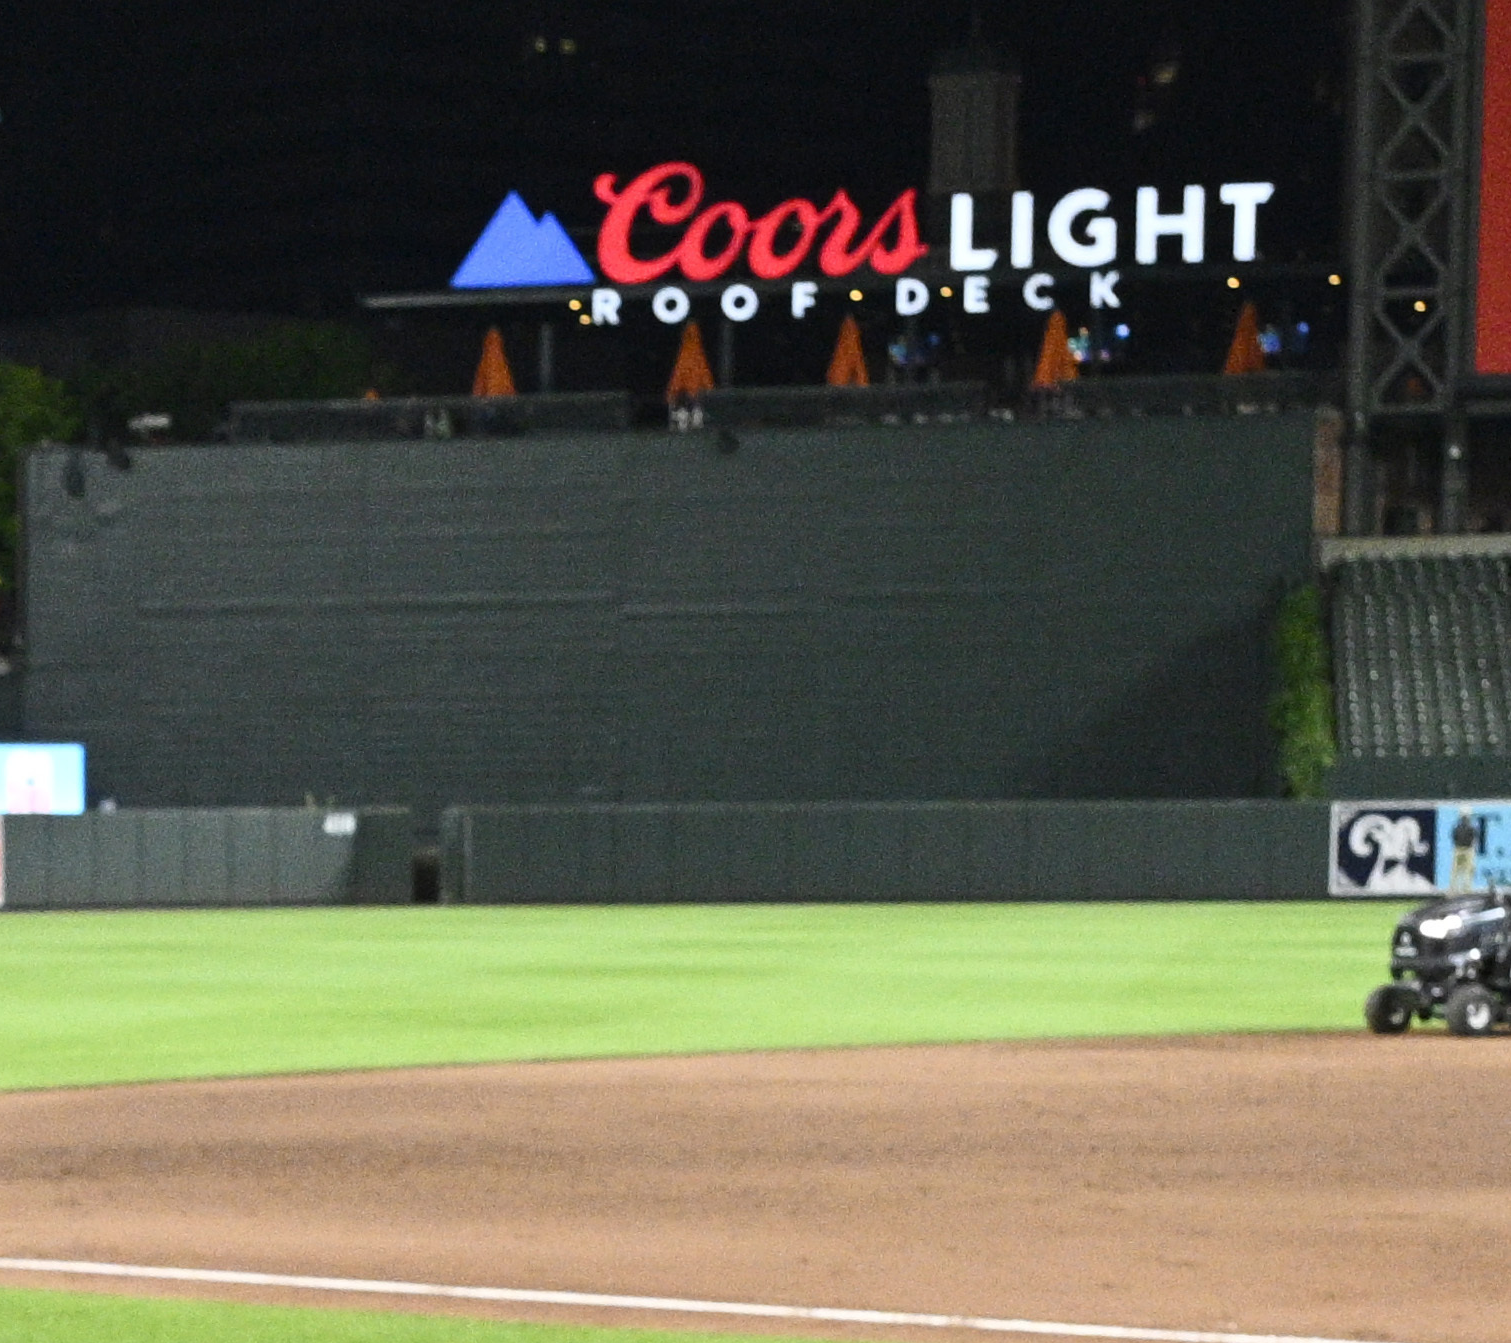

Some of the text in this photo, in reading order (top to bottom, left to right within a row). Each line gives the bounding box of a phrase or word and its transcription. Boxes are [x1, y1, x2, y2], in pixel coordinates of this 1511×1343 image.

[592, 161, 1274, 283] Coors LIGHT
[592, 270, 1121, 326] ROOF DECK
